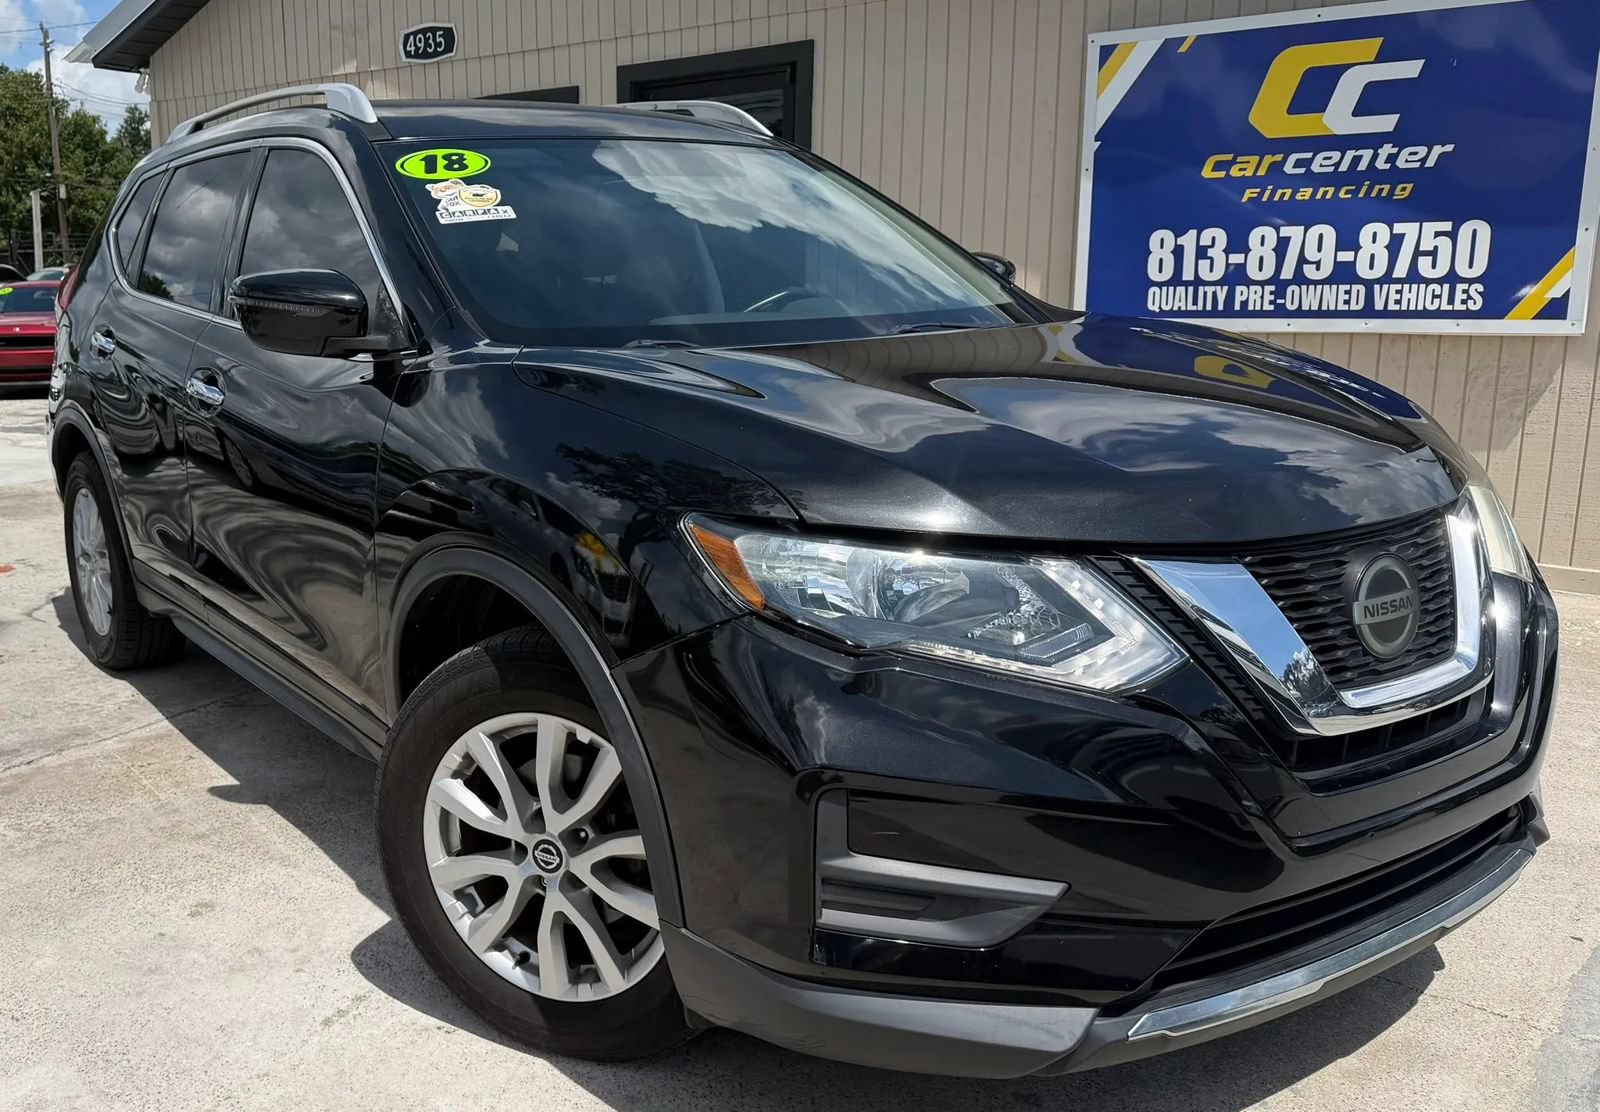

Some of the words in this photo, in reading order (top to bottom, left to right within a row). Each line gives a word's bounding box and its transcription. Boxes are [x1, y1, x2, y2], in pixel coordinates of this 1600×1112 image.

[406, 31, 445, 55] 4935
[419, 153, 469, 174] 18
[1240, 181, 1414, 203] Financing
[1147, 219, 1492, 282] 813-879-8750
[1147, 286, 1229, 313] QUALITY
[1234, 284, 1366, 311] PRE-OWNED
[1373, 283, 1484, 311] VEHICLES
[1363, 595, 1414, 619] NISSAN
